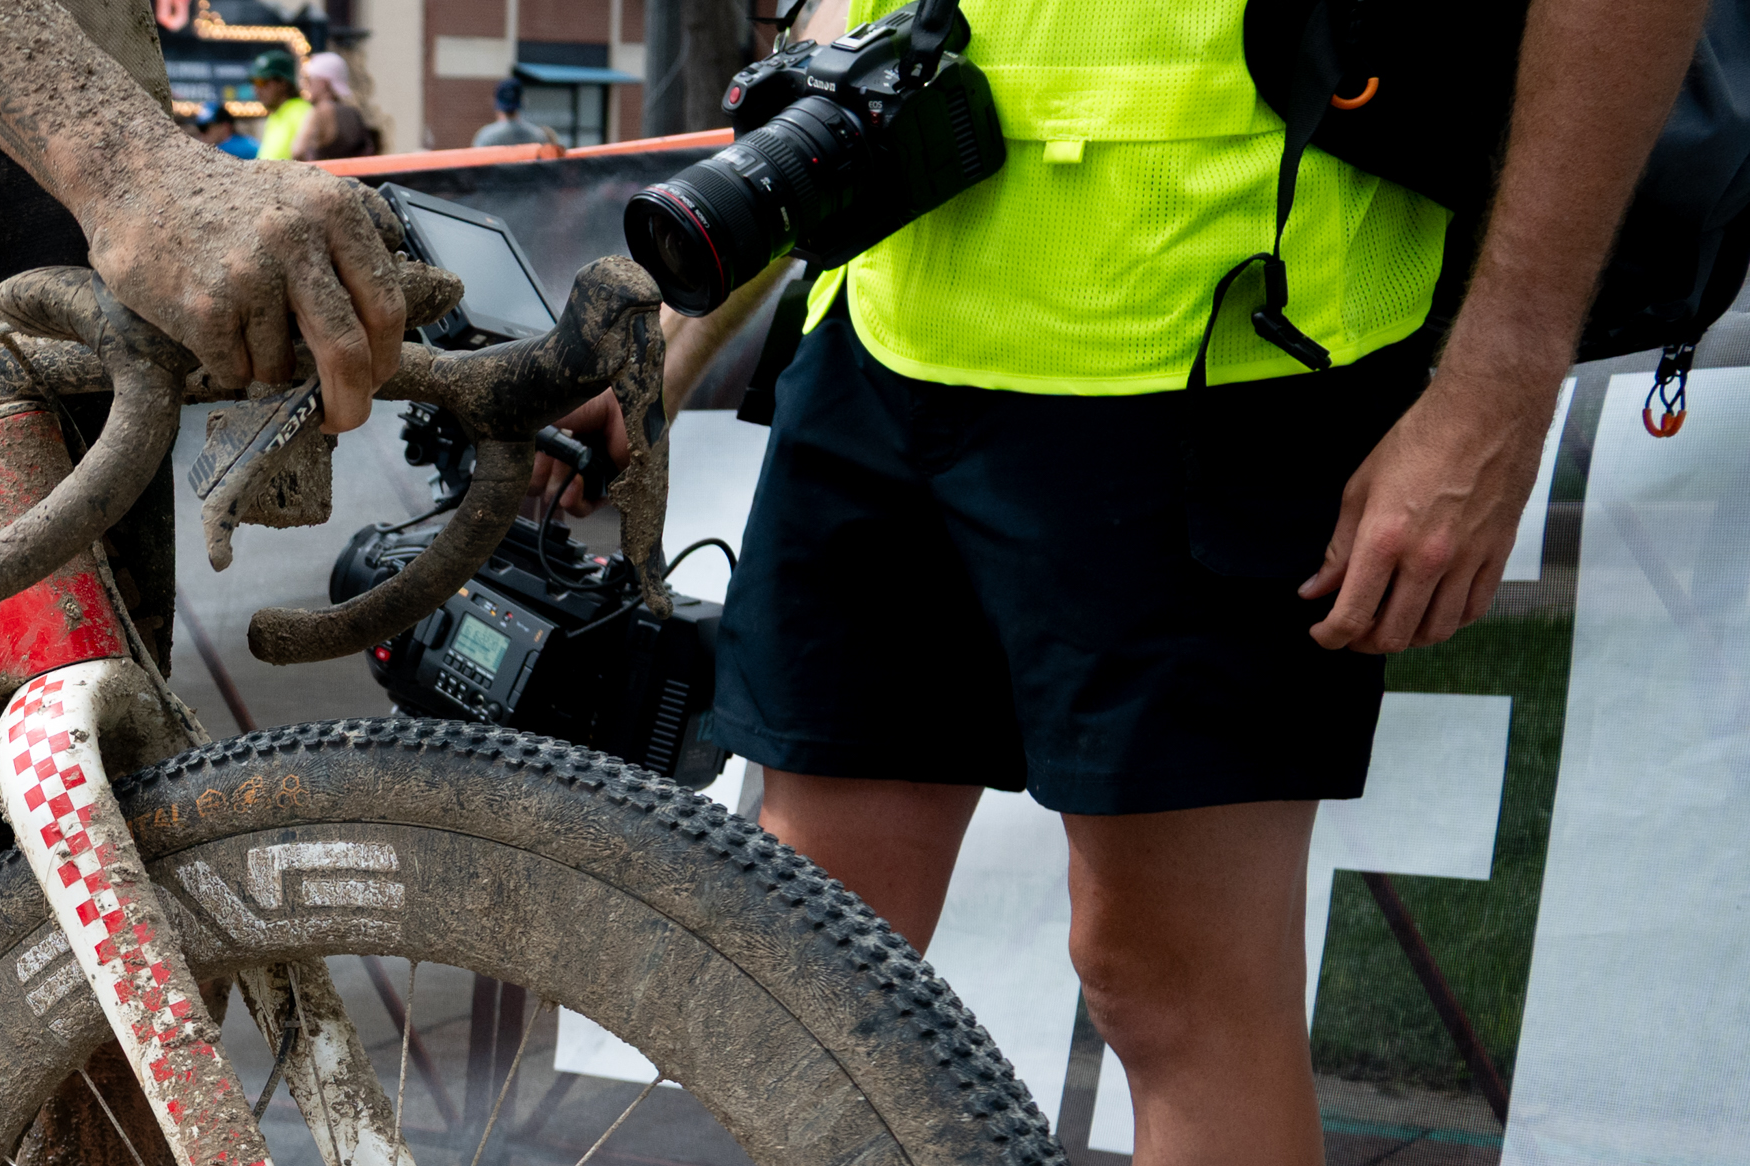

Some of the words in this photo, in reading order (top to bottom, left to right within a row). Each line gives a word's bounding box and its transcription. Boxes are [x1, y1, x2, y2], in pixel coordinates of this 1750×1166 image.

[806, 75, 837, 93] Canon
[868, 100, 883, 109] EOS
[694, 208, 710, 229] CANON
